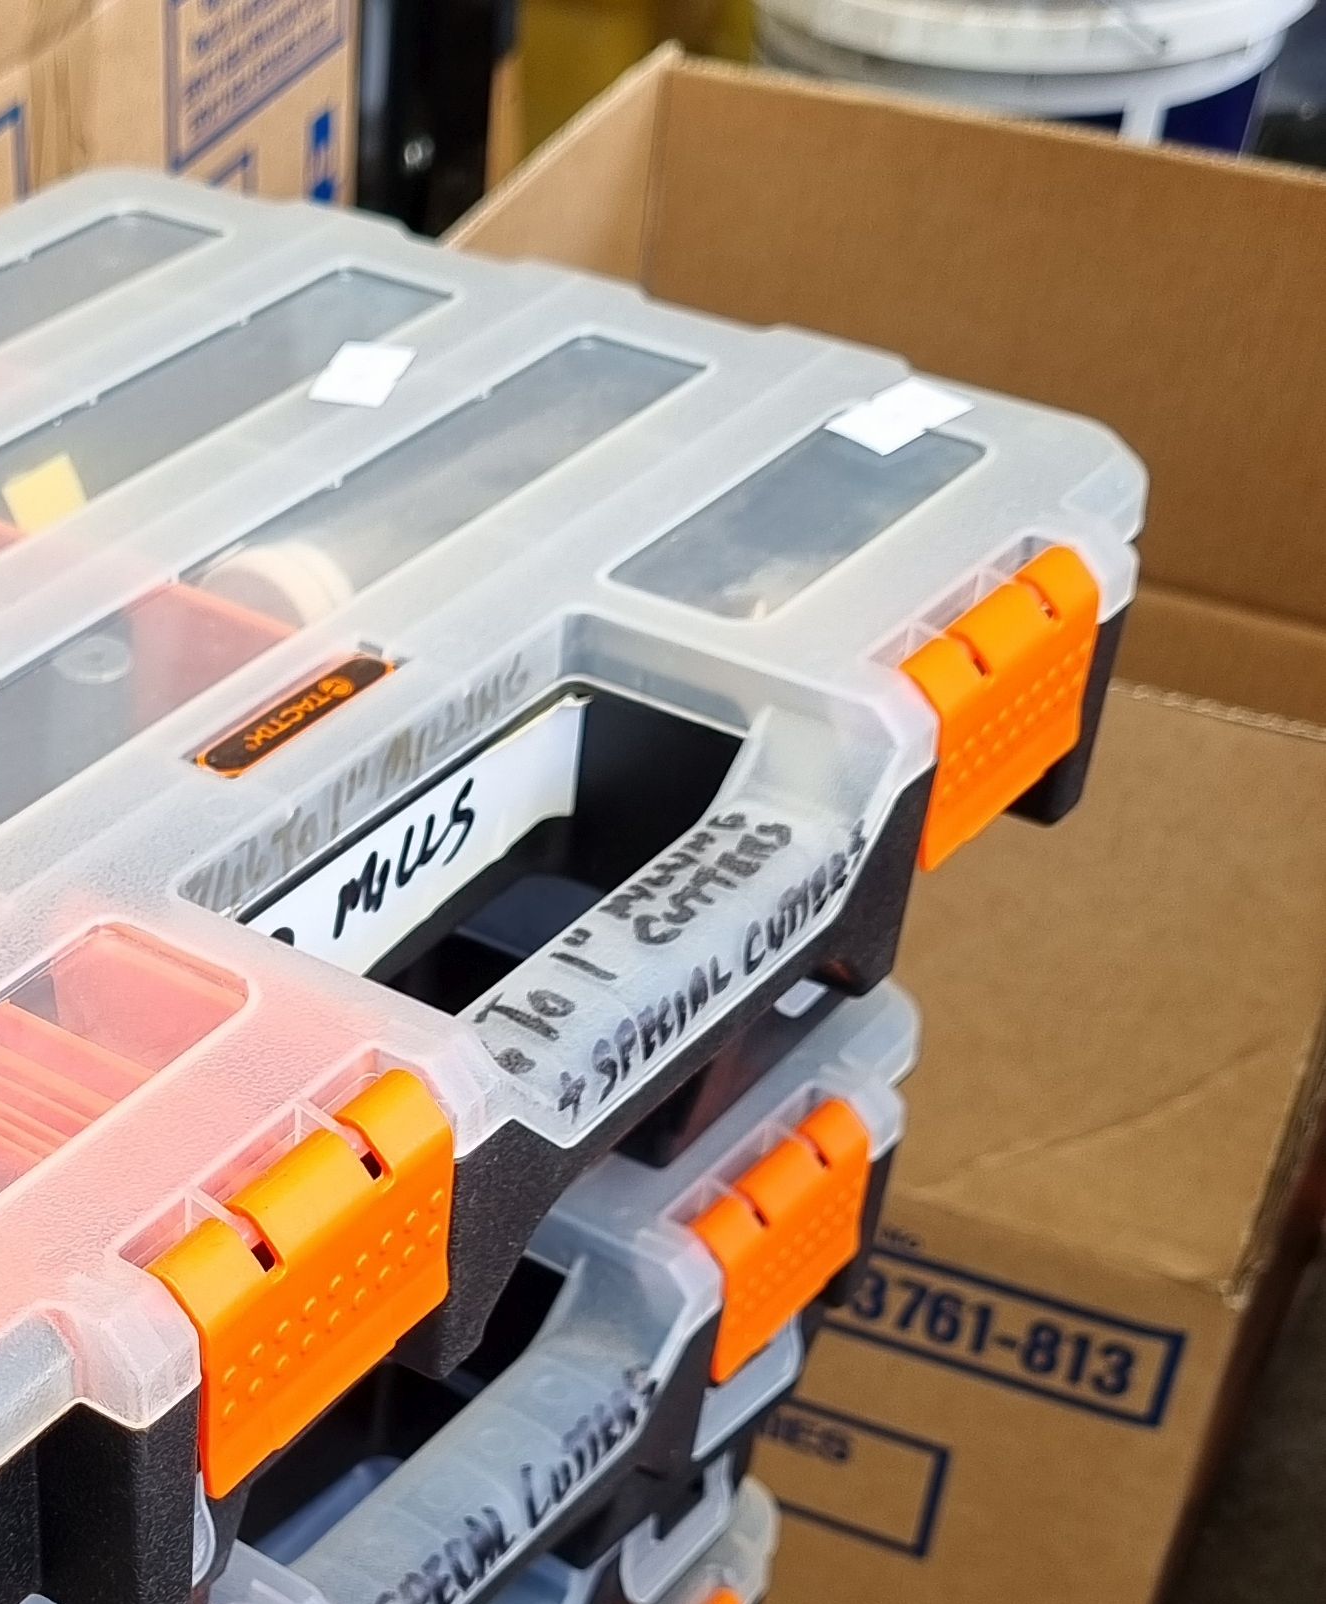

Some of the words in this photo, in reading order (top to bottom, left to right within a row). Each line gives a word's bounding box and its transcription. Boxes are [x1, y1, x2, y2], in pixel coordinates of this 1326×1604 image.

[242, 688, 338, 752] TACTIX
[333, 777, 475, 940] MILLS
[852, 1270, 1136, 1397] 3761-813
